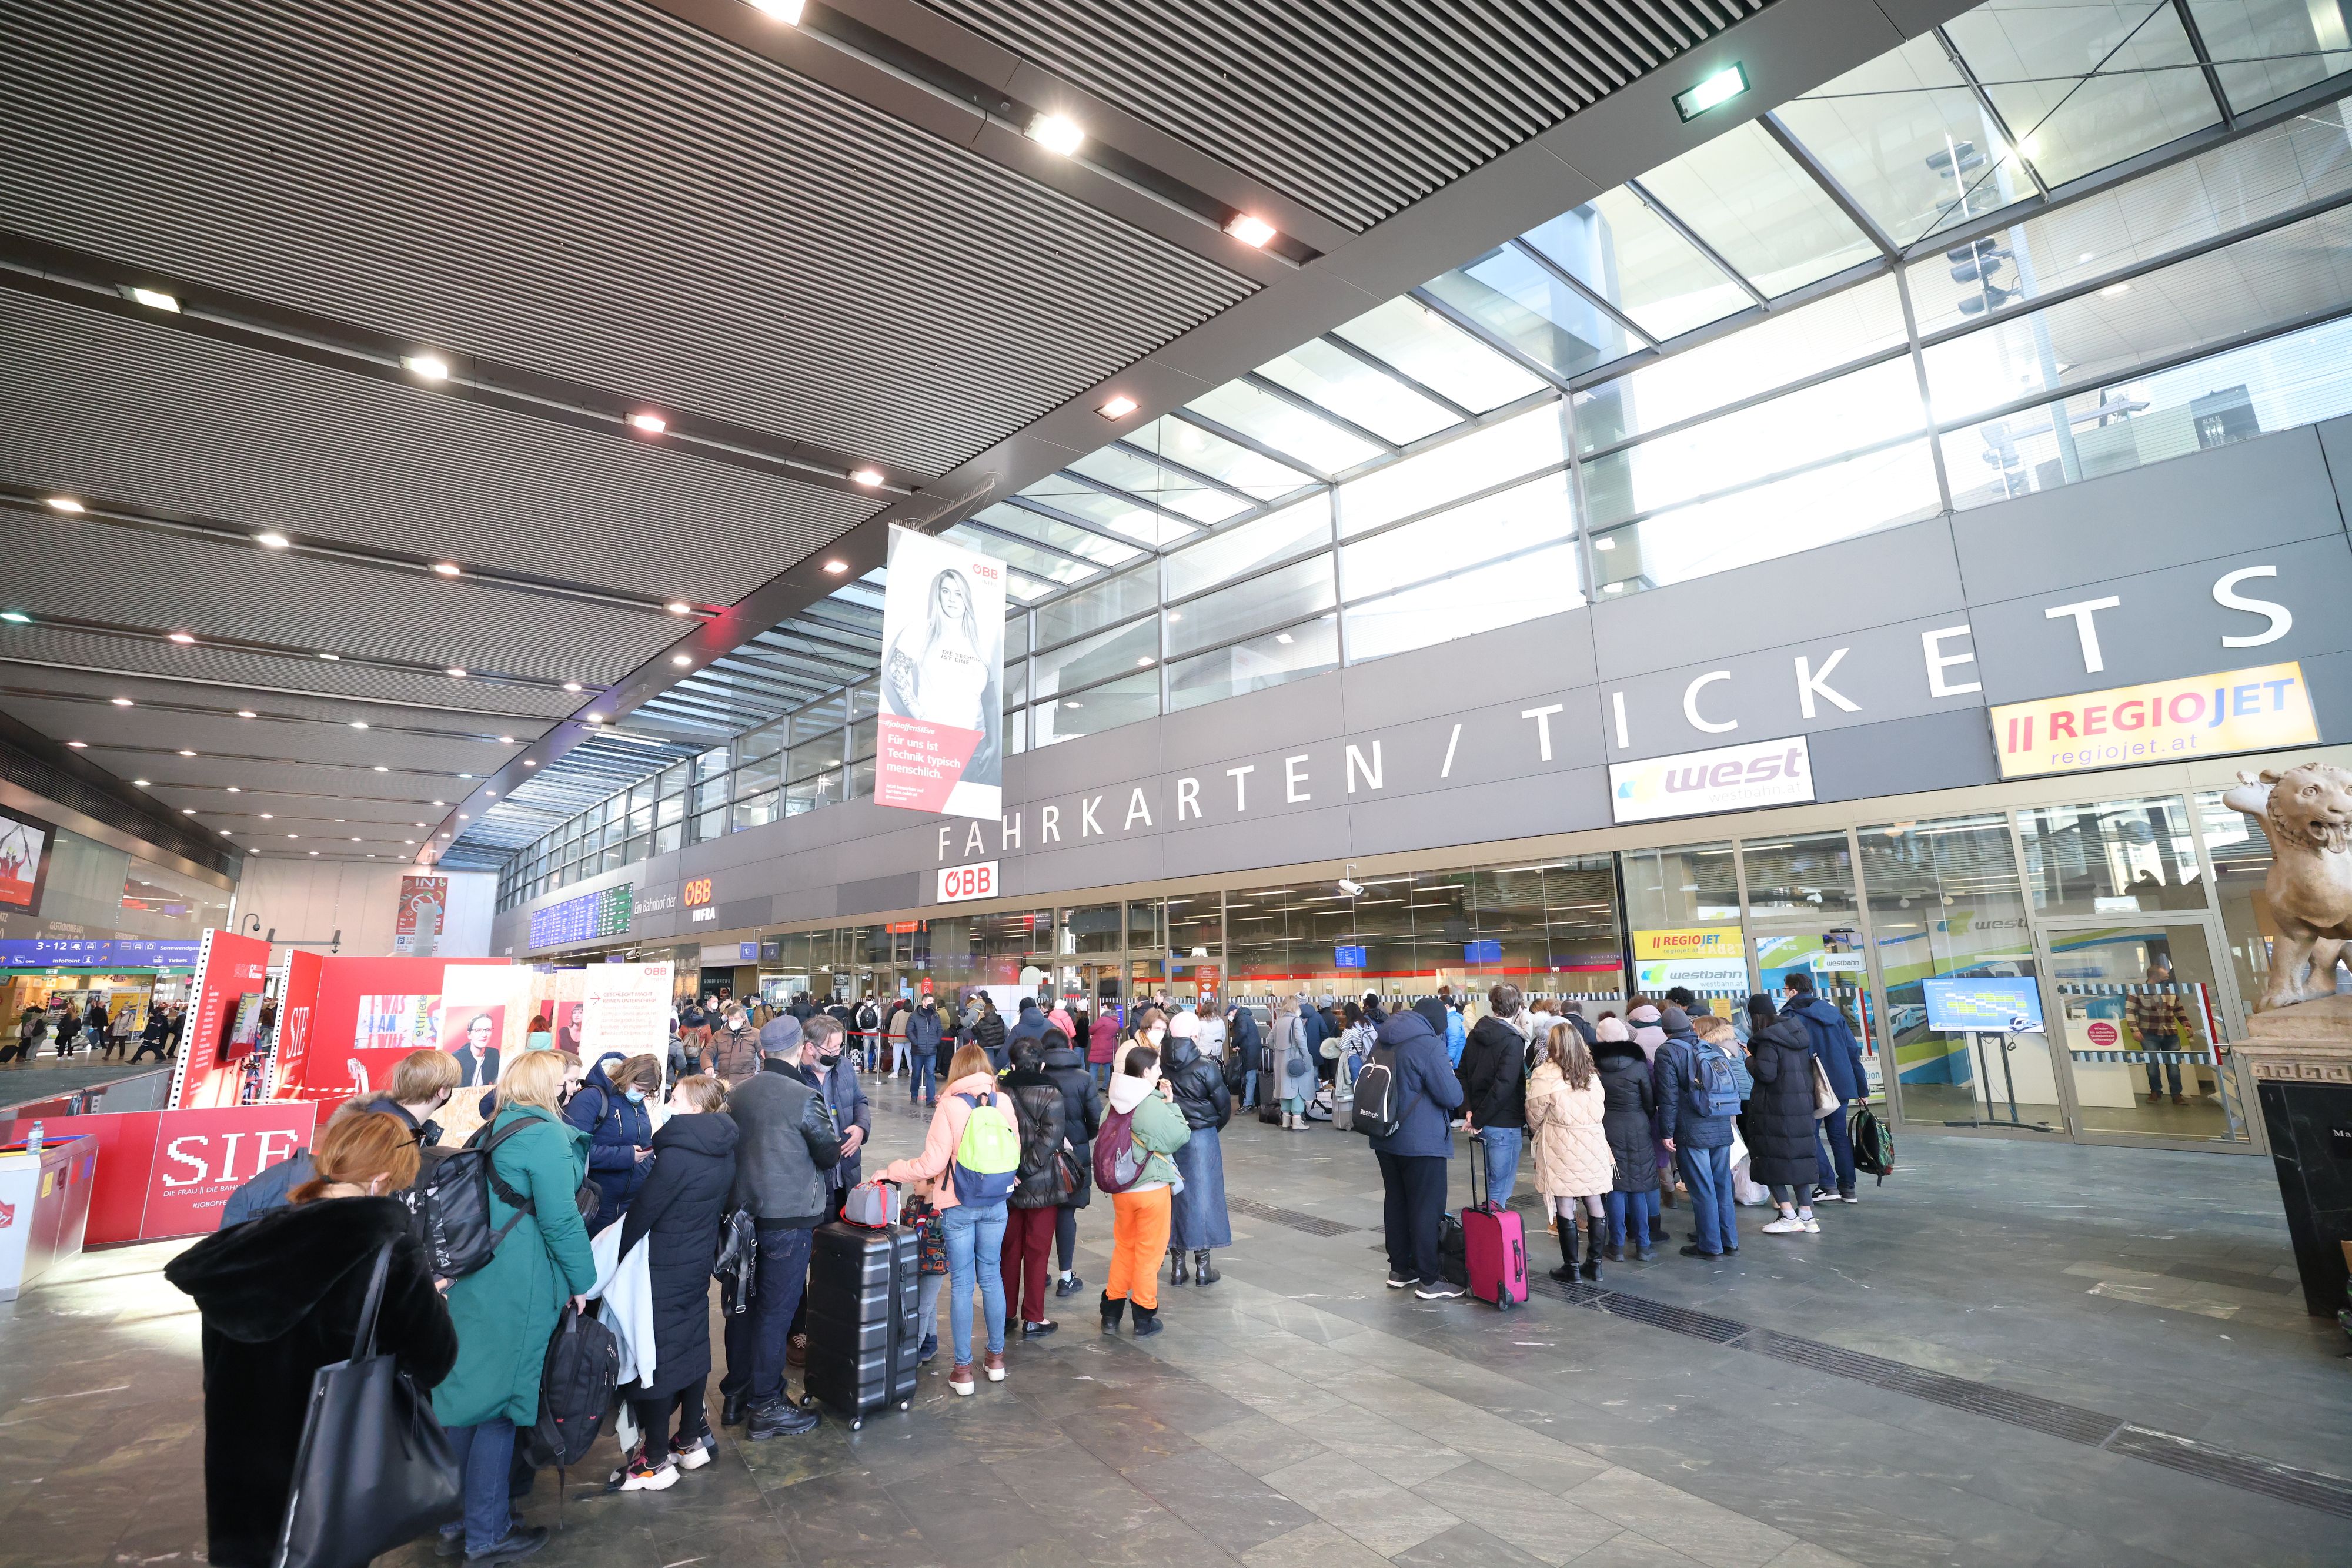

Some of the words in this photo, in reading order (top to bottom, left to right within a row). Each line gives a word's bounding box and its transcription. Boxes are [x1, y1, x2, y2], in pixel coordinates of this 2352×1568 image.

[973, 563, 998, 580] ÖBB
[955, 653, 980, 663] TECHNIK
[938, 740, 1384, 861] FAHRKARTEN
[1521, 565, 2293, 762] TICKETS
[2049, 678, 2294, 741] REGIOJET
[884, 719, 935, 735] #joboffenSIEve
[888, 734, 904, 745] Für
[907, 738, 924, 749] uns
[927, 741, 938, 751] ist
[2052, 734, 2197, 765] regiojet.at
[887, 747, 924, 763] Technik
[927, 755, 960, 768] typisch
[887, 763, 943, 779] menschlich.
[1665, 747, 1803, 793] west
[1709, 780, 1802, 803] westbahn.at
[944, 867, 991, 898] ÖBB
[684, 878, 711, 906] ÖBB
[643, 894, 666, 913] Bahnhof
[666, 893, 676, 909] der
[693, 907, 716, 922] INFRA
[49, 921, 76, 933] GASTRONOMIE
[1663, 934, 1720, 947] REGIOJET
[644, 967, 667, 975] ÖBB
[1670, 970, 1742, 979] westbahn
[382, 995, 407, 1015] WAS
[377, 1014, 396, 1033] AM
[415, 995, 427, 1037] elfriede
[286, 1007, 309, 1059] SIE
[1359, 1108, 1379, 1119] Reebok
[2332, 1129, 2352, 1138] Ma
[178, 1188, 198, 1196] FRAU
